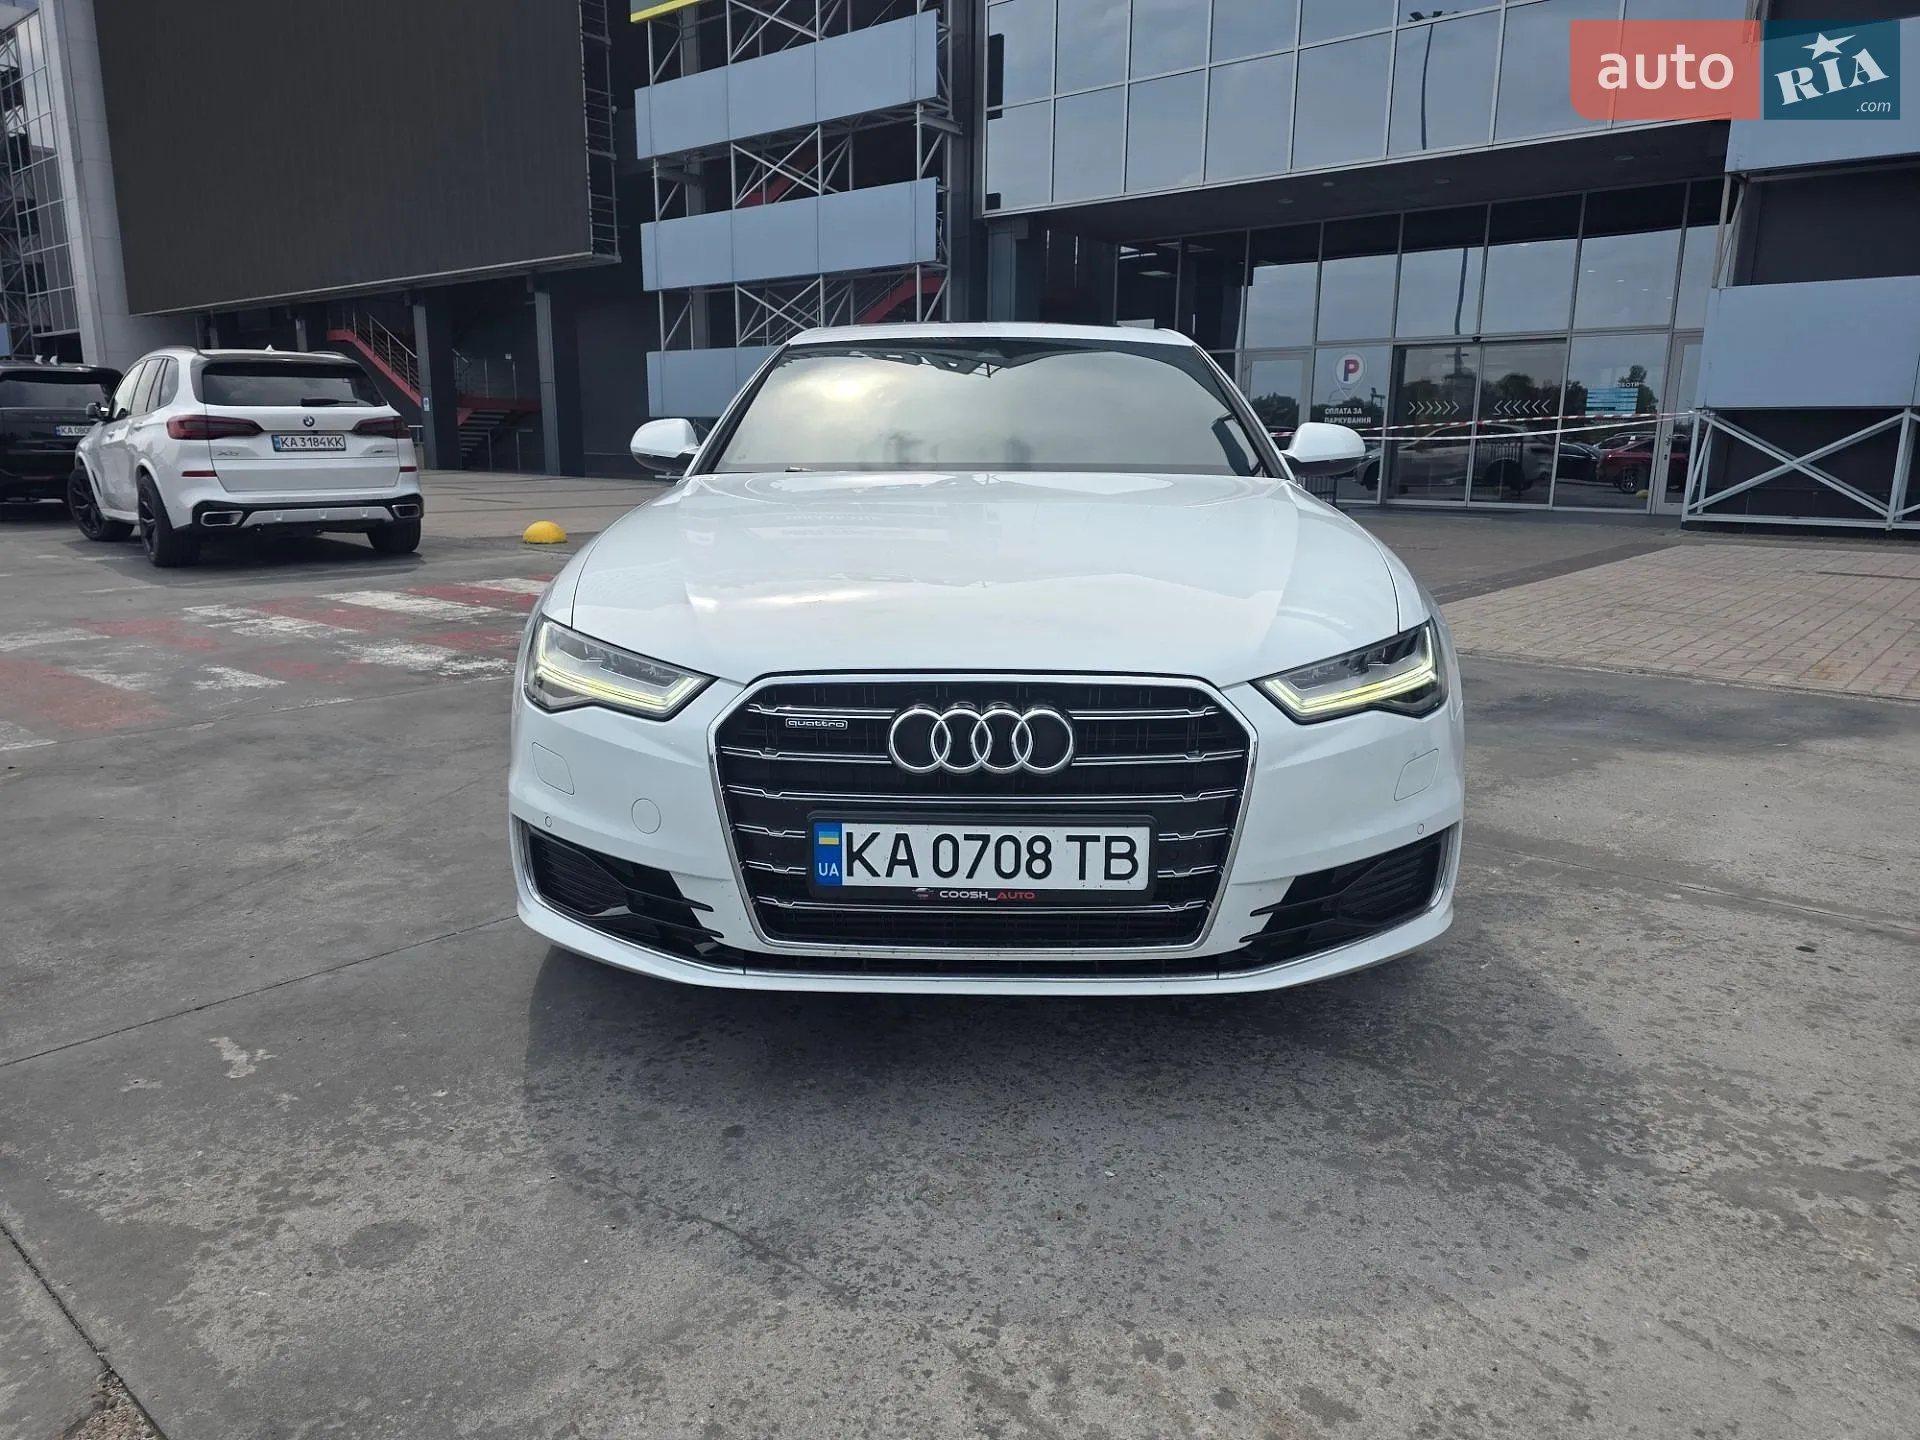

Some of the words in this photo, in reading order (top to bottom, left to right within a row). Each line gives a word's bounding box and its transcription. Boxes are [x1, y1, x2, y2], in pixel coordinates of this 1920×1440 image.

[1324, 407, 1352, 415] ОПЛАТА
[1353, 407, 1362, 415] ЗА
[1324, 416, 1372, 424] ПАРКУВАННЯ
[280, 436, 298, 448] KA
[299, 436, 326, 448] 3184
[326, 436, 344, 448] KK
[788, 719, 845, 728] quattro
[845, 831, 919, 879] KA
[931, 832, 1053, 880] 0708
[1065, 834, 1139, 882] TB
[818, 862, 839, 877] UA
[939, 890, 1035, 901] COOSH_AUTO
